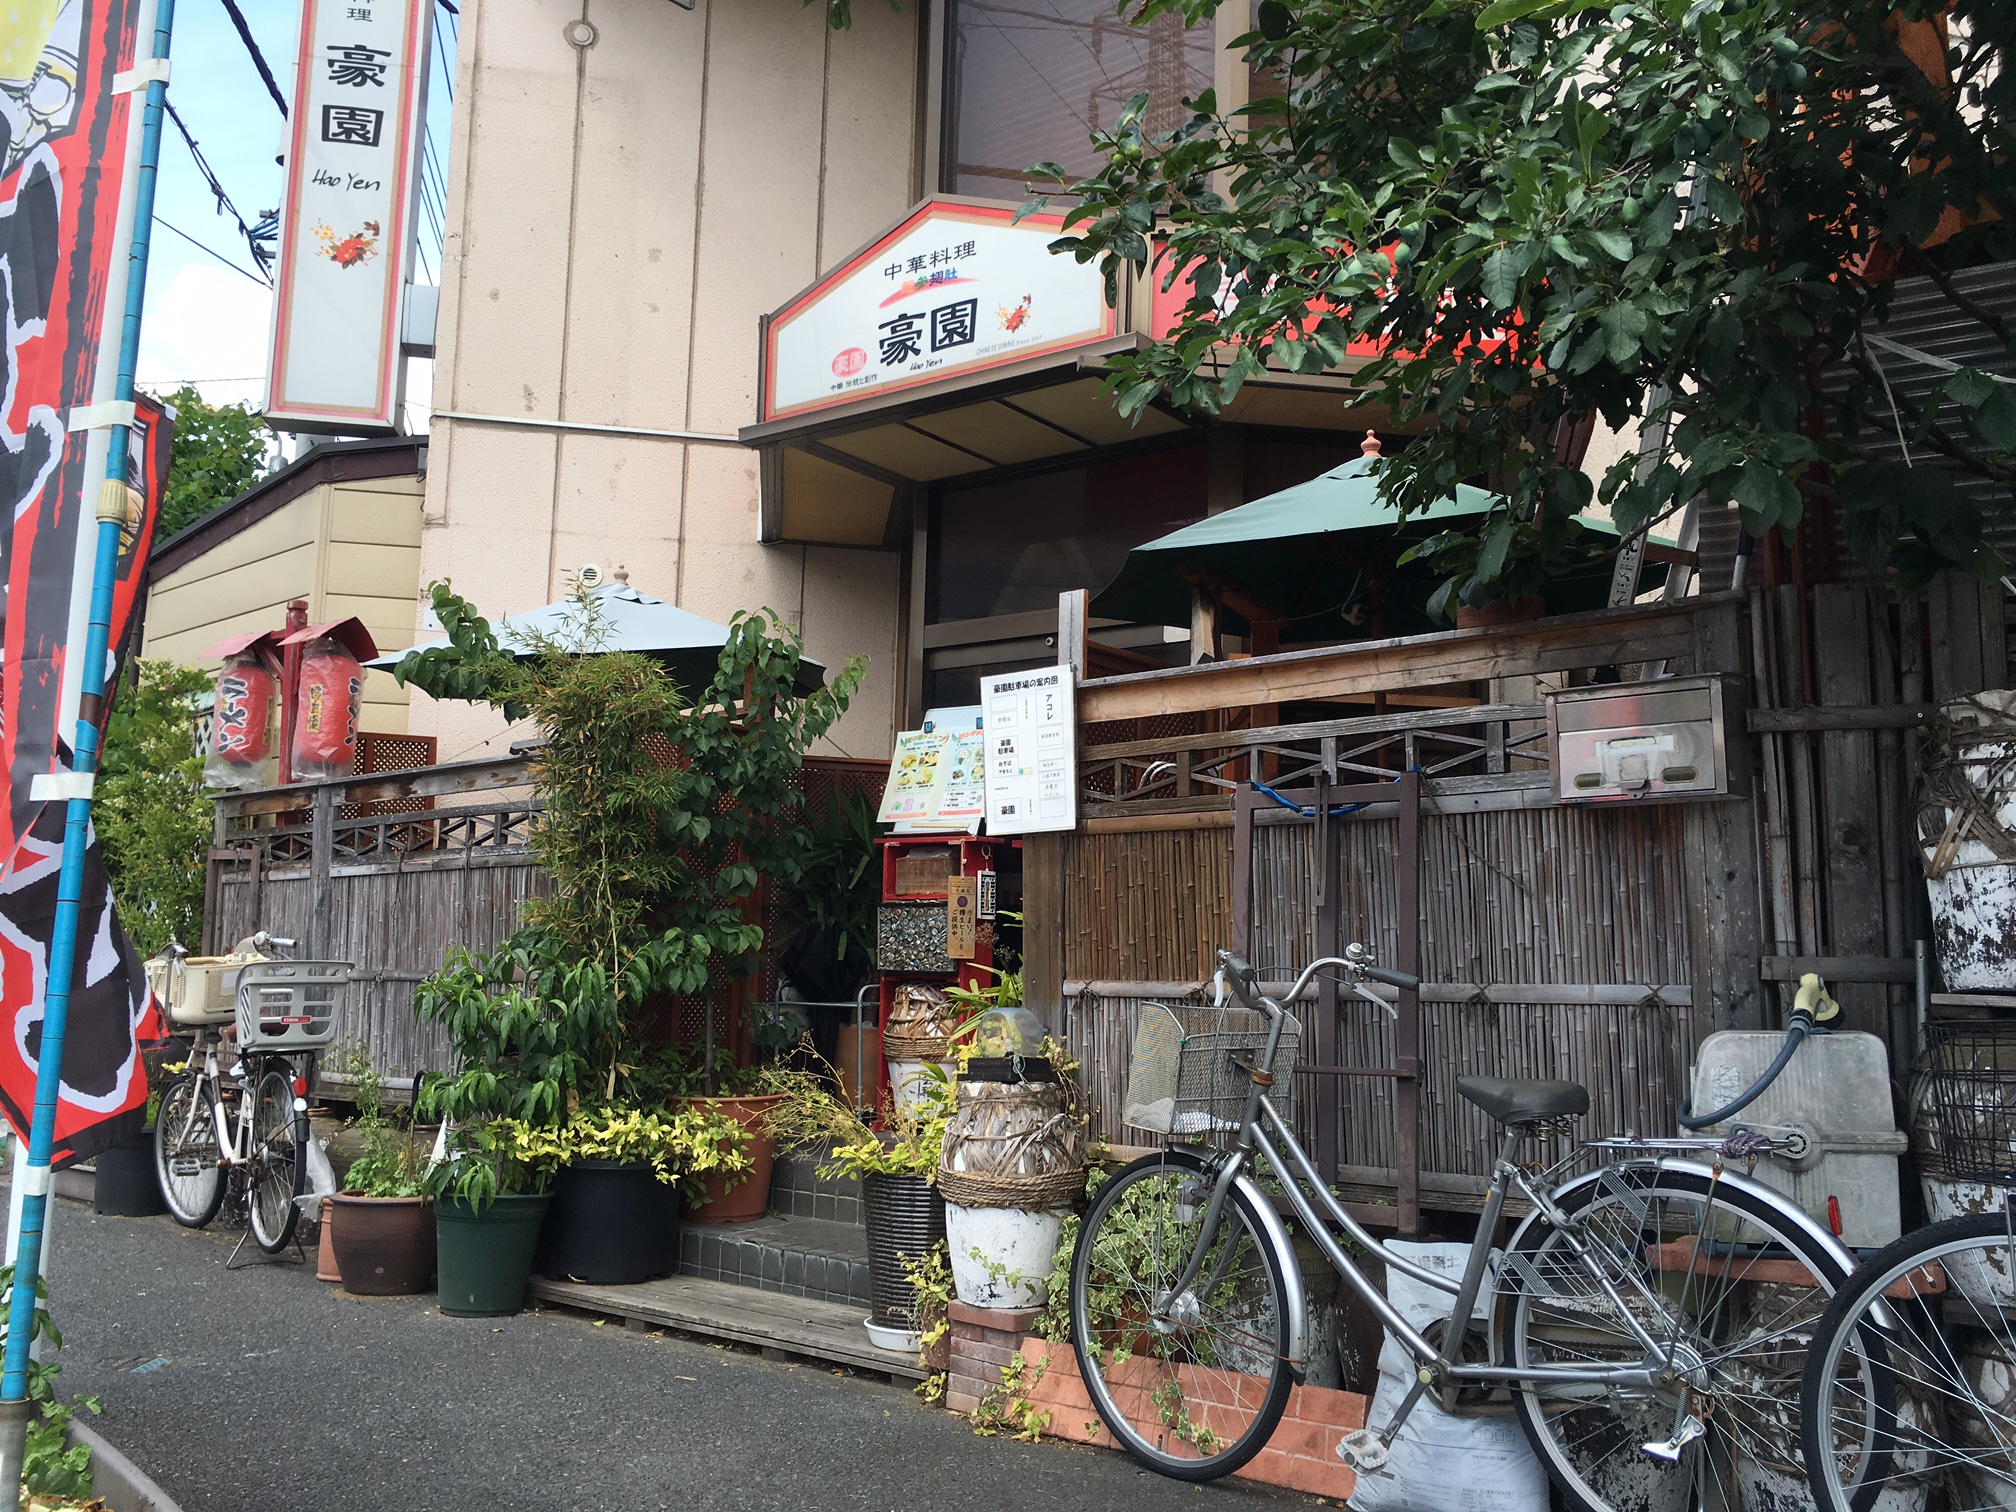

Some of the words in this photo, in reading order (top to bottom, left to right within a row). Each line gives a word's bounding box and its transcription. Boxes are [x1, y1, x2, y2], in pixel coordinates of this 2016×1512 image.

[321, 44, 392, 147] 豪園
[311, 168, 341, 187] Hao
[346, 172, 381, 192] Yen
[884, 240, 977, 281] 中華料理
[877, 298, 979, 367] 豪園
[976, 344, 998, 356] CHINESE
[998, 340, 1015, 350] DINING
[834, 351, 866, 376] 豪園
[909, 361, 923, 371] Hao
[925, 357, 943, 370] Yen
[993, 675, 1058, 694] 豪園駐車場の案内図
[218, 677, 249, 752] ラーメン
[1001, 805, 1016, 815] 豪園
